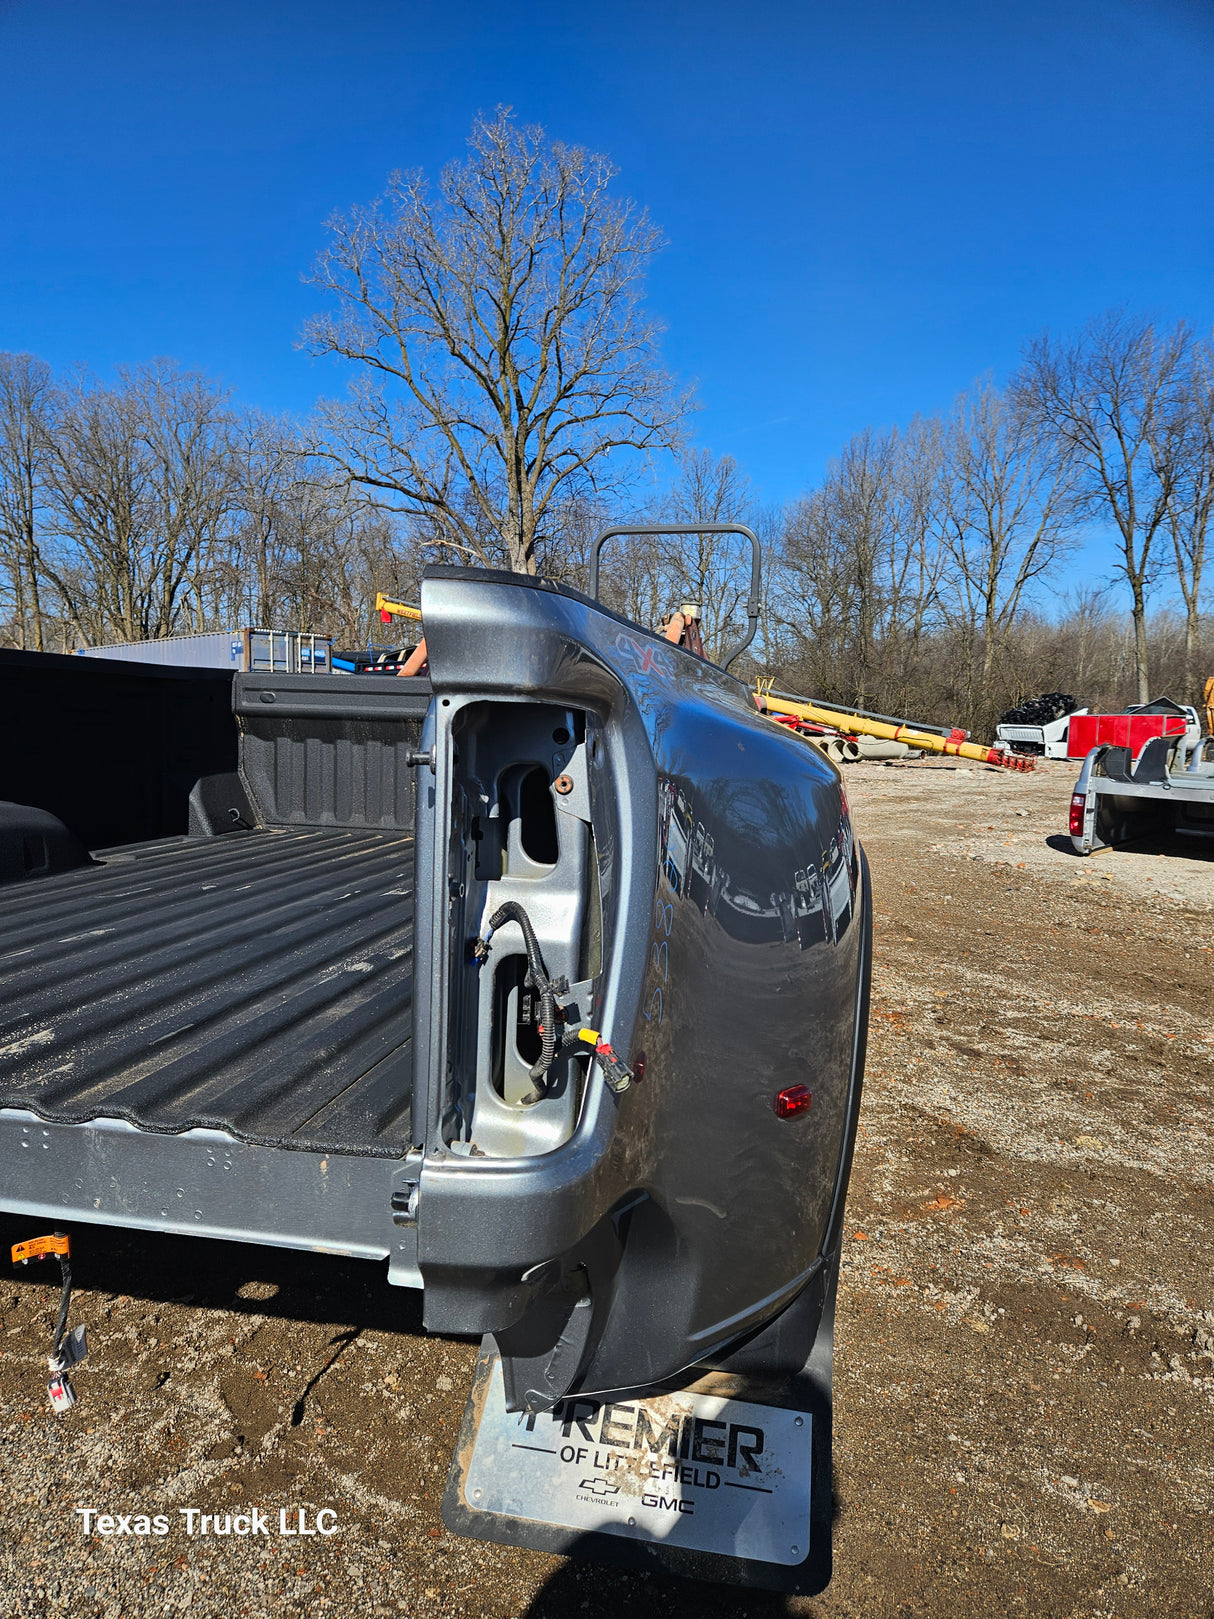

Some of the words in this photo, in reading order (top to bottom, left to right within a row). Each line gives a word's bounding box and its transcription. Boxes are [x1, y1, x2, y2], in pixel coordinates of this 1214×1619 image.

[560, 1445, 589, 1465] OF
[593, 1450, 721, 1490] LITEFIELD
[575, 1493, 619, 1508] CHEVROLET
[641, 1492, 695, 1515] GMC
